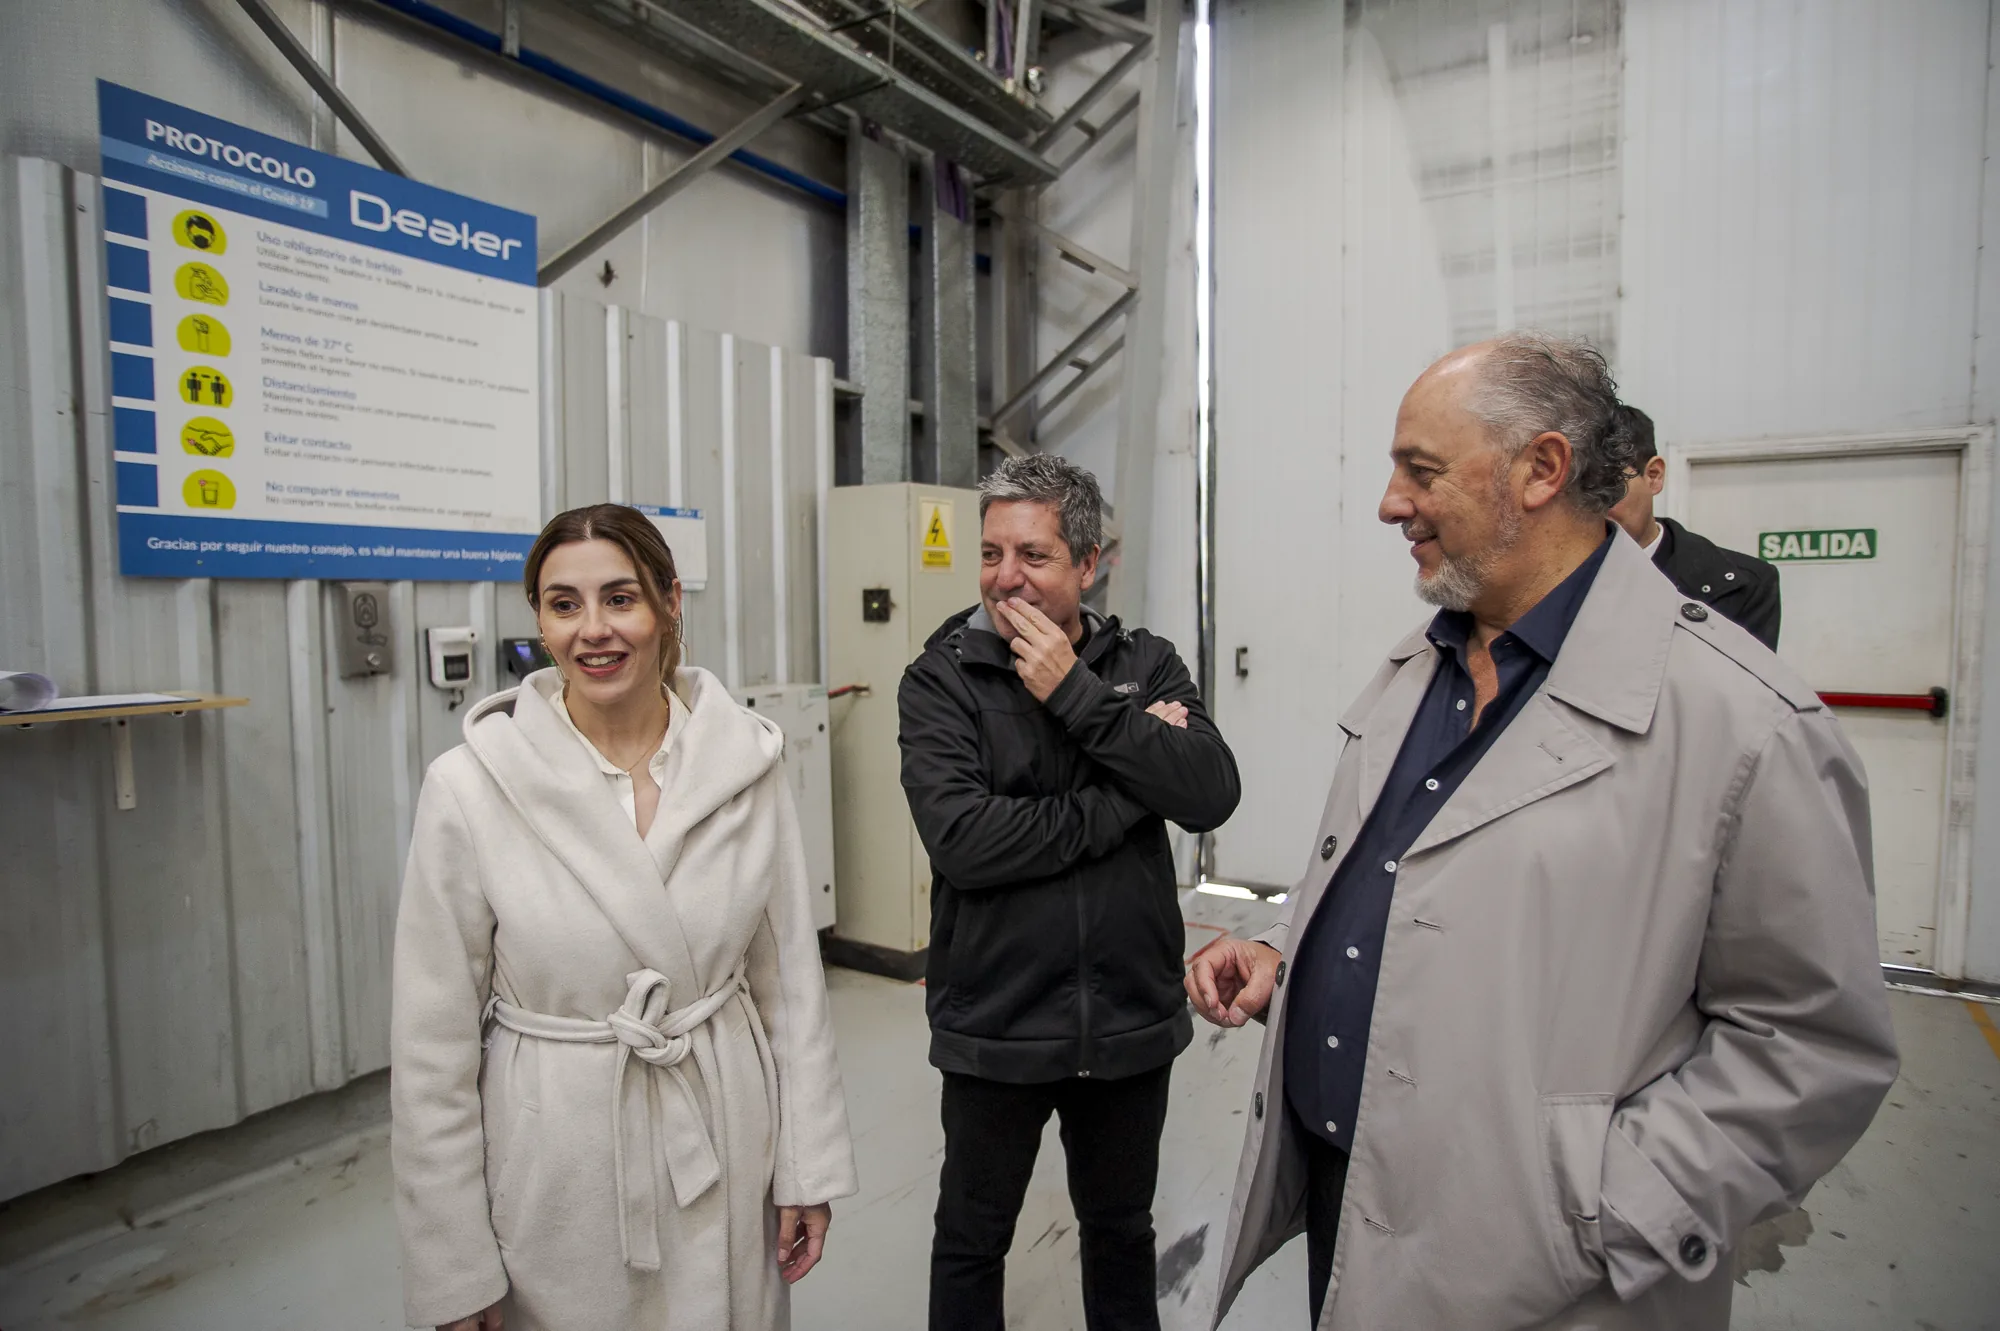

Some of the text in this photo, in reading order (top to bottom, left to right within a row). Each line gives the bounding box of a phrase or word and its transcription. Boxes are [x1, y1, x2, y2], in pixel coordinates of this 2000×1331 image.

[145, 118, 316, 188] PROTOCOLO
[147, 153, 207, 181] Acciones
[207, 172, 248, 192] contra
[250, 182, 262, 195] el
[350, 189, 522, 261] Dealer
[256, 230, 281, 246] Uso
[283, 239, 347, 262] obligatorio
[349, 254, 362, 267] de
[366, 258, 403, 275] barbijo
[259, 280, 359, 311] Lavado de manos
[261, 326, 301, 343] Menos
[304, 335, 320, 347] de
[344, 342, 354, 354] C
[262, 376, 357, 400] Distanciamiento
[264, 431, 352, 451] Evitar contacto
[265, 480, 400, 501] No compartir elementos
[147, 537, 198, 551] Gracias
[200, 540, 223, 553] por
[225, 540, 263, 555] seguir
[264, 543, 311, 555] nuestro
[311, 544, 358, 558] consejo,
[358, 546, 372, 557] es
[372, 545, 395, 557] vital
[395, 547, 442, 559] mantener
[442, 550, 461, 560] una
[461, 548, 490, 561] buena
[1761, 532, 1871, 559] SALIDA
